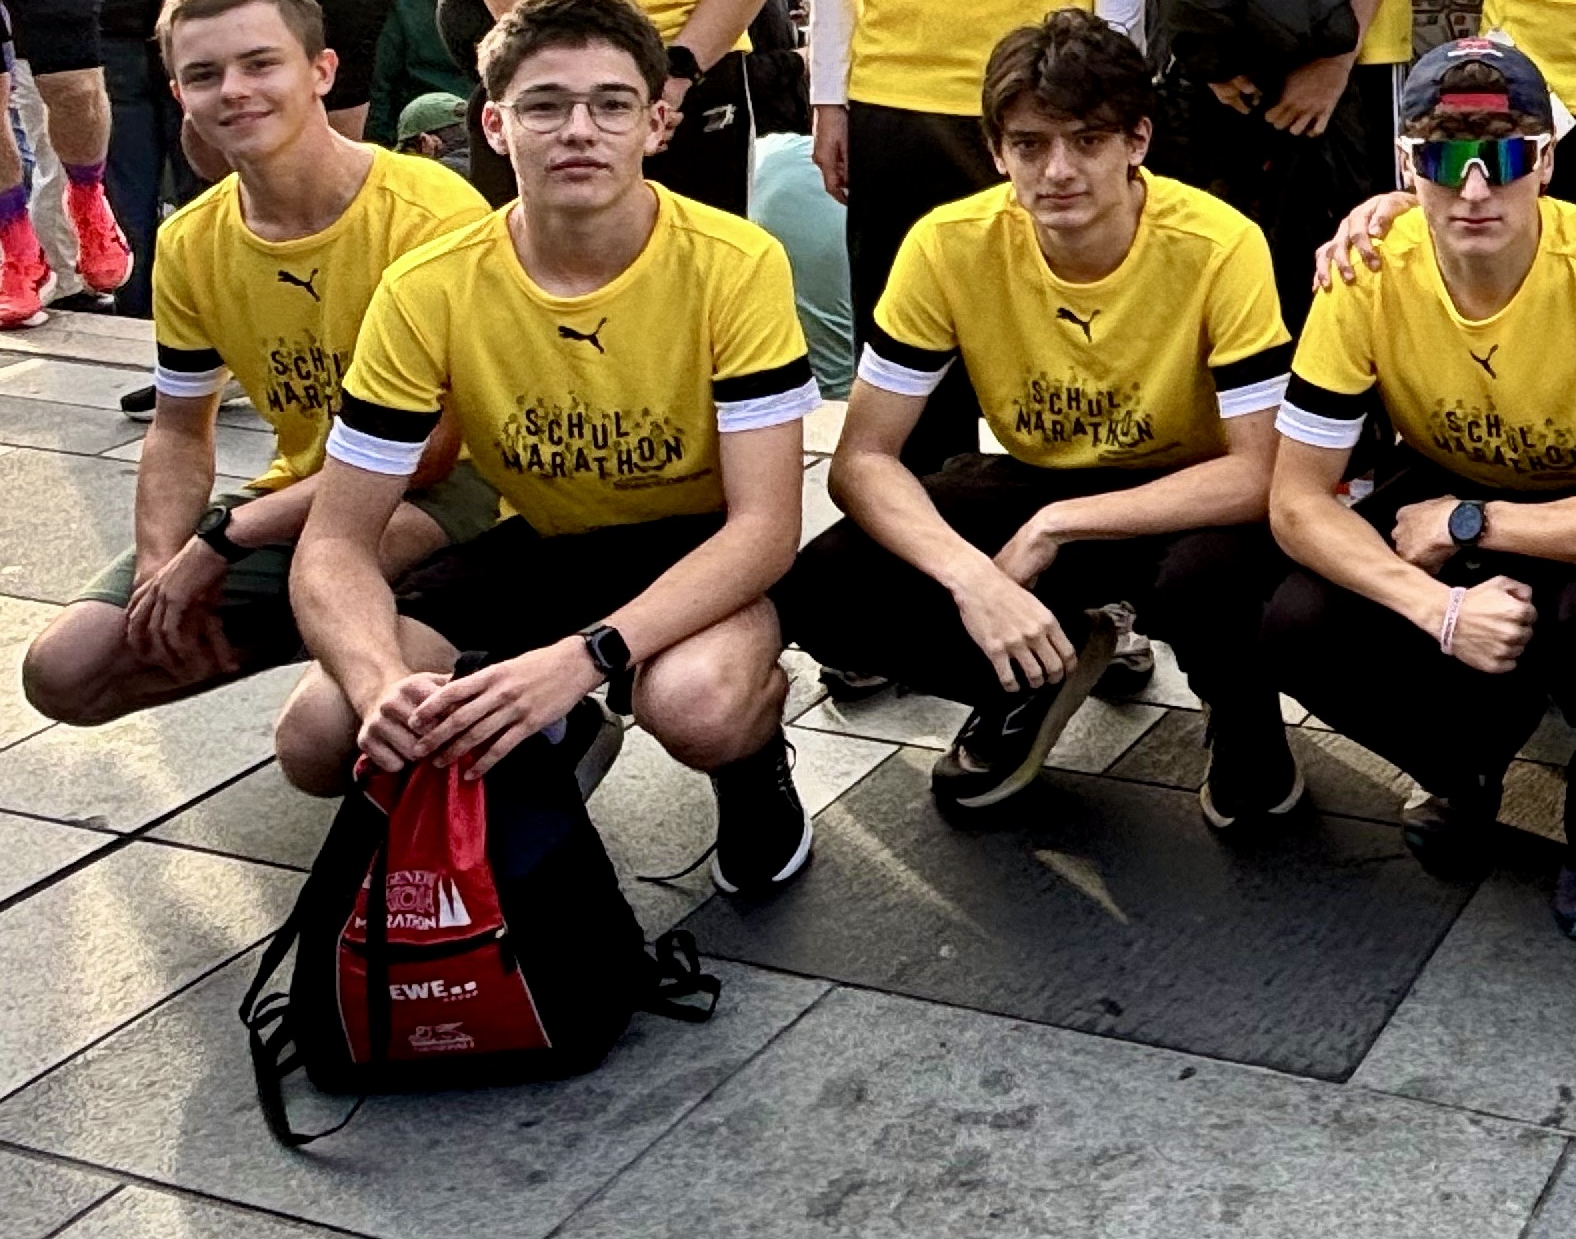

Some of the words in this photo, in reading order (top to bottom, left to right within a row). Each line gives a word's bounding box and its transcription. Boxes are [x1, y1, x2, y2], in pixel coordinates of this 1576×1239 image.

[1032, 380, 1121, 417] SCHUL
[525, 409, 630, 450] SCHUL
[1015, 407, 1155, 448] MARATHON
[1445, 411, 1536, 454] SCHUL
[501, 436, 683, 480] MARATHON
[389, 979, 449, 1001] EWE
